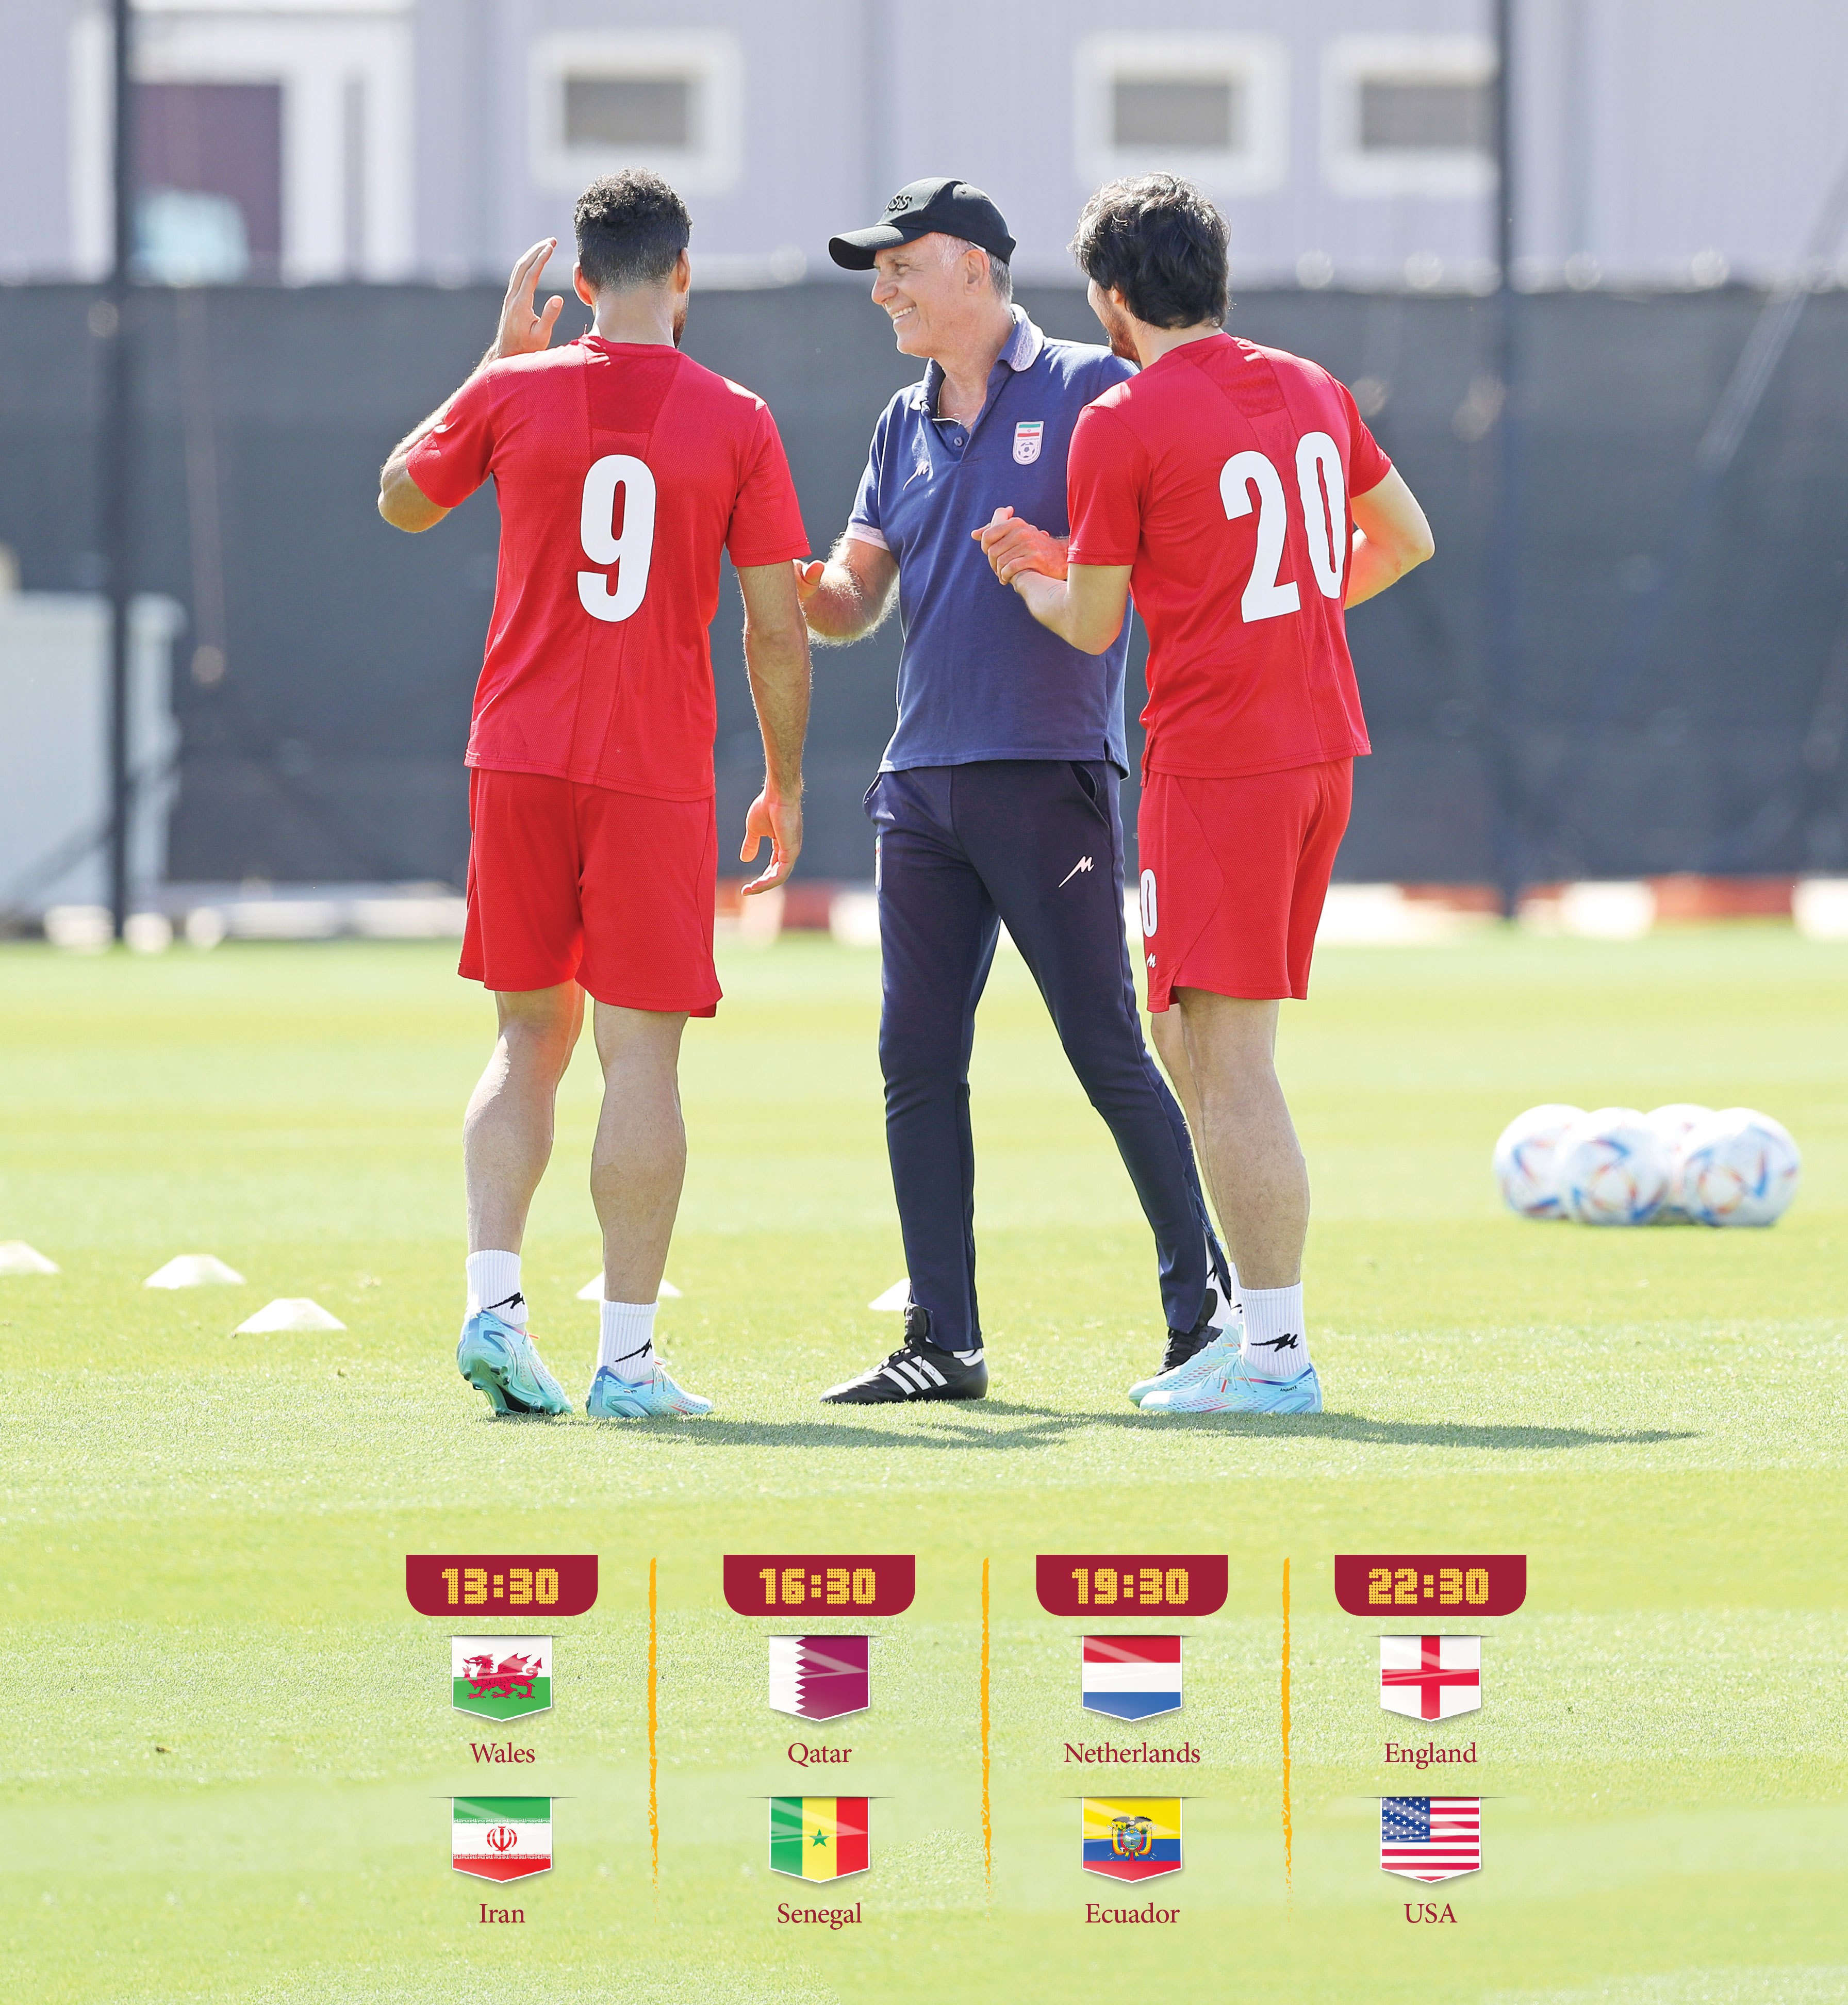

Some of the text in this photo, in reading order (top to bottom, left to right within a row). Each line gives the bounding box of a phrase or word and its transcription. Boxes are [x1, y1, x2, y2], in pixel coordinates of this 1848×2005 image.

[885, 194, 912, 211] SS
[577, 454, 656, 622] 9
[1219, 431, 1346, 623] 20
